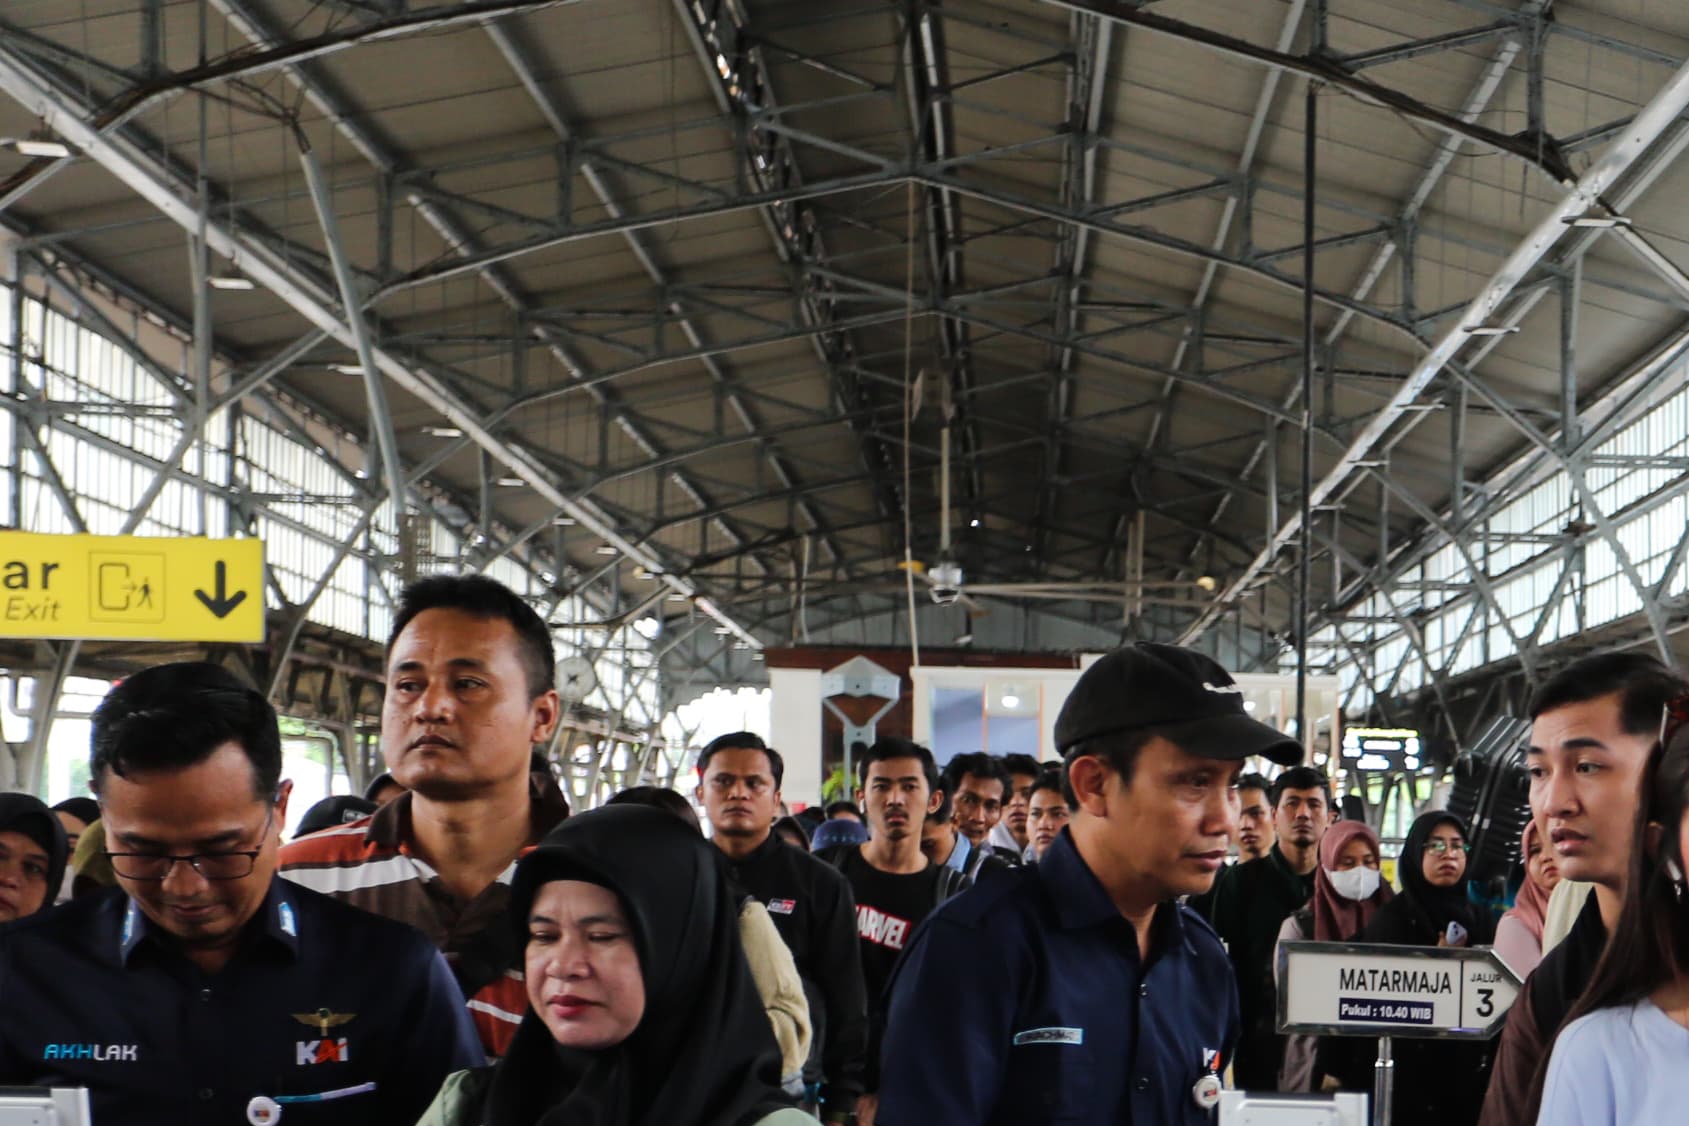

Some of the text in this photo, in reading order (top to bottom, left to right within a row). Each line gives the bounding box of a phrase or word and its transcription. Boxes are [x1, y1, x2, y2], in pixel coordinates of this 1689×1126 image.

[5, 597, 61, 621] Exit
[855, 905, 907, 950] ARVEL
[1339, 967, 1452, 995] MATARMAJA
[1341, 1003, 1371, 1017] Pukul
[1380, 1005, 1409, 1018] 10.40
[1410, 1007, 1432, 1020] WIB
[1476, 988, 1494, 1018] 3
[43, 1043, 139, 1061] AKHLAK
[296, 1036, 349, 1065] KAI
